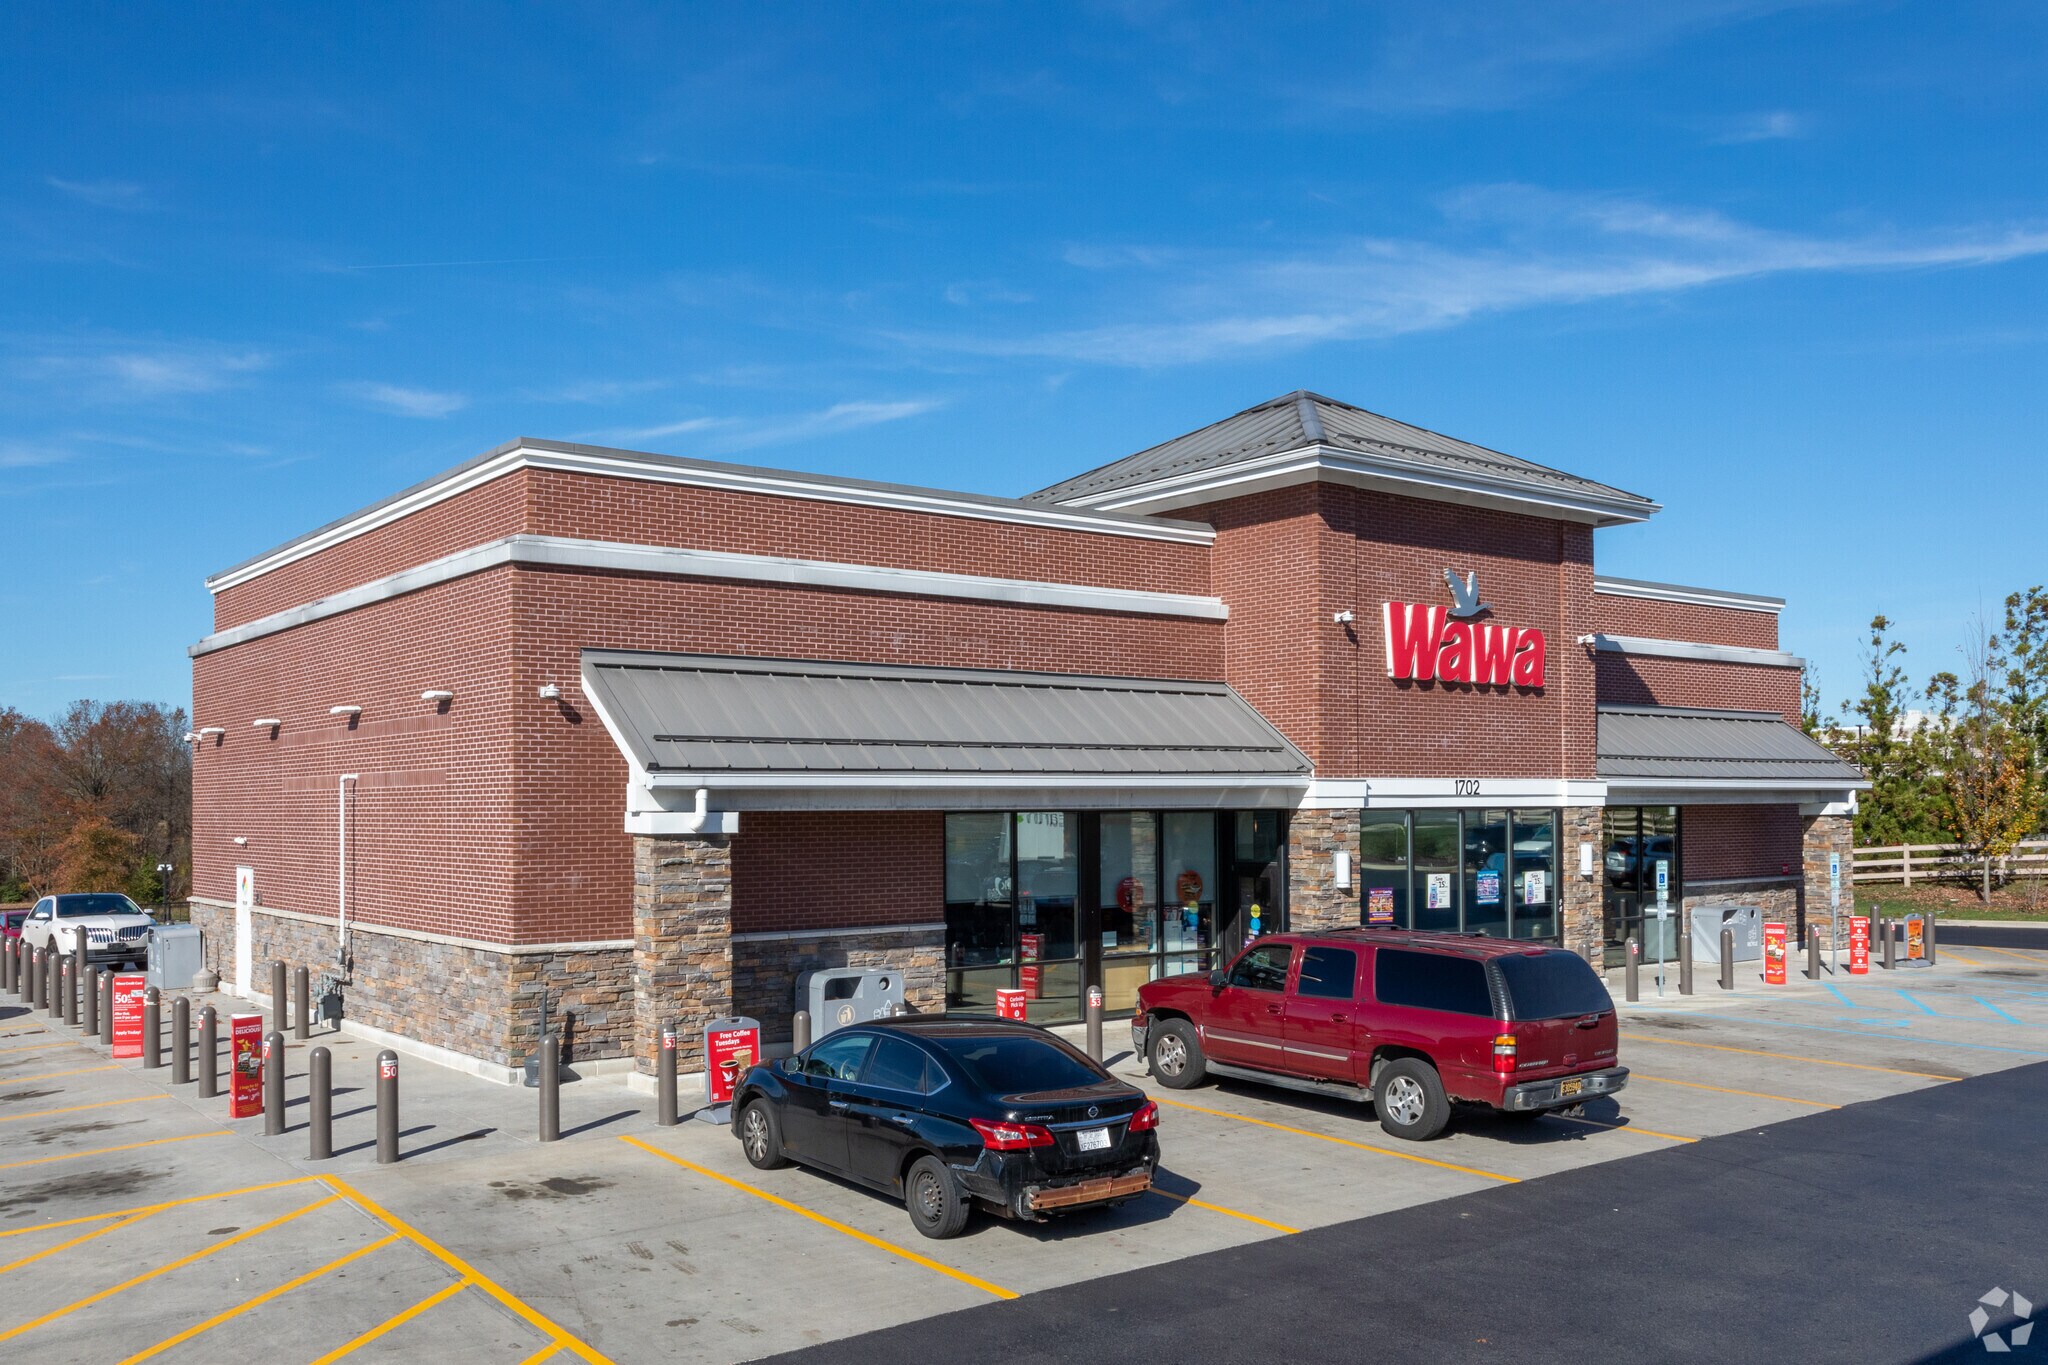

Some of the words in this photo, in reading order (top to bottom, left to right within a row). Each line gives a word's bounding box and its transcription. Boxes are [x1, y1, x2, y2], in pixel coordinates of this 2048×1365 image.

[1383, 601, 1546, 688] Wawa
[1455, 780, 1480, 795] 1702
[1091, 998, 1102, 1007] 53
[733, 1030, 751, 1038] Coffee
[665, 1038, 676, 1048] 51
[715, 1038, 740, 1047] Tuesdays
[383, 1066, 397, 1078] 50
